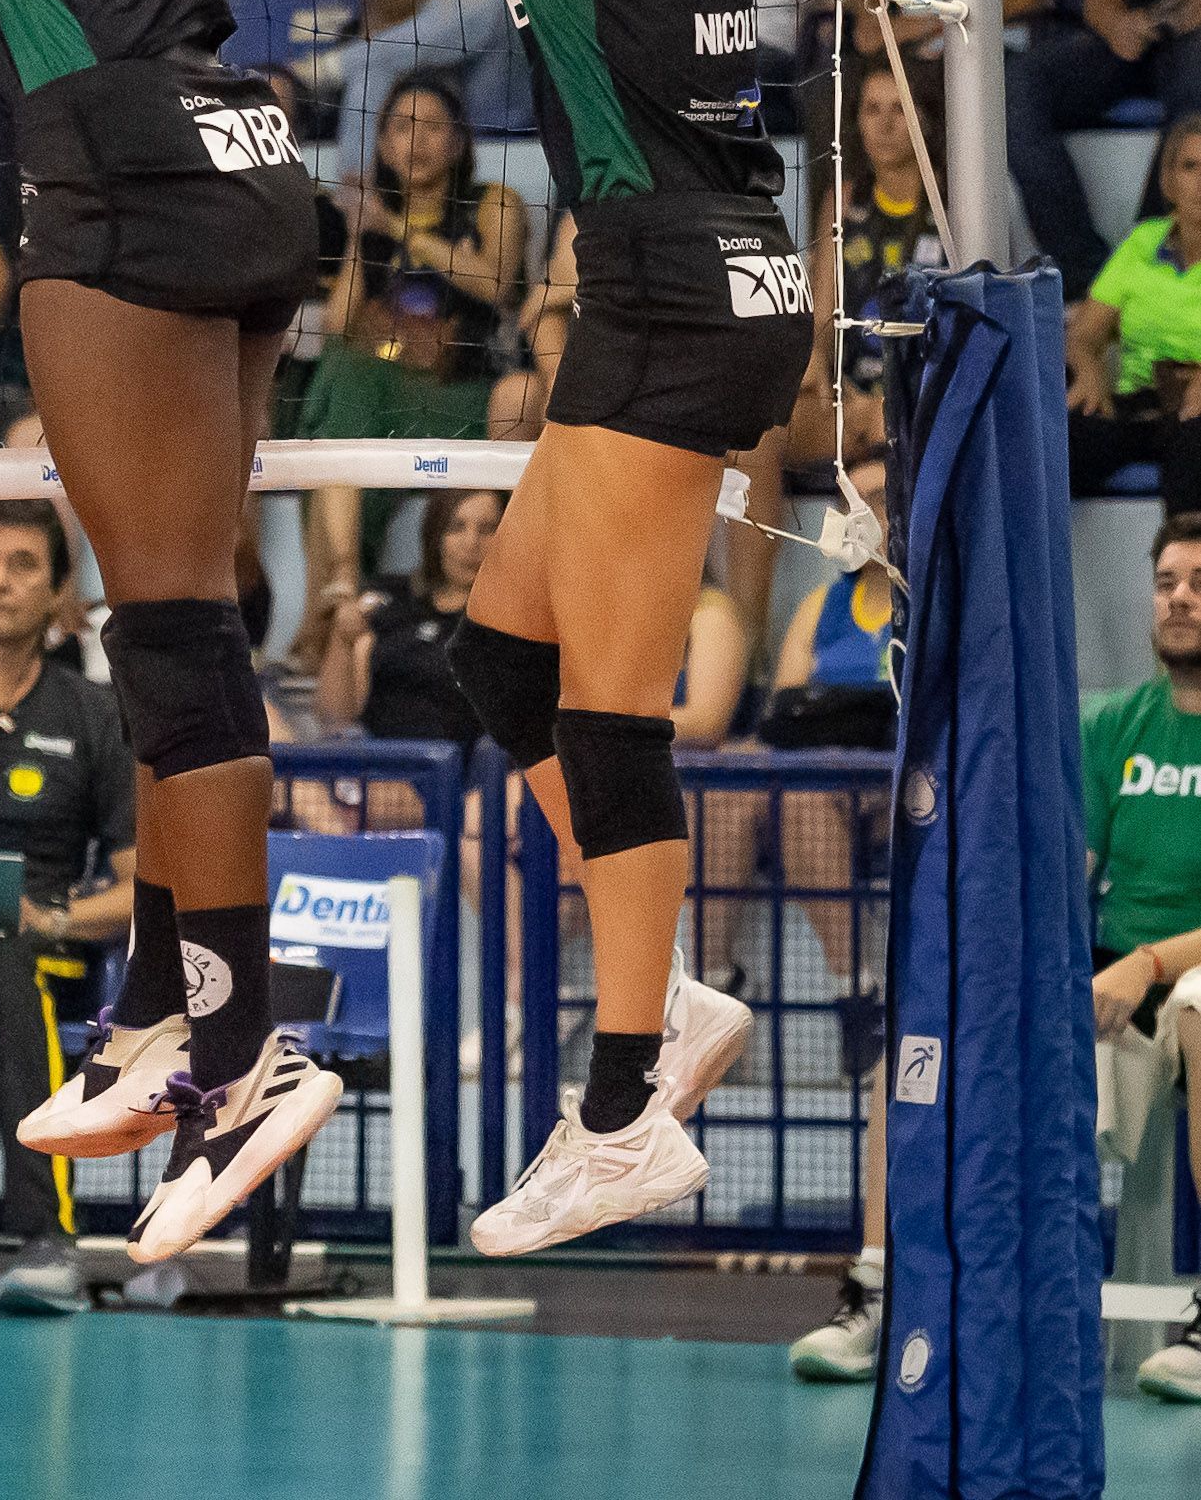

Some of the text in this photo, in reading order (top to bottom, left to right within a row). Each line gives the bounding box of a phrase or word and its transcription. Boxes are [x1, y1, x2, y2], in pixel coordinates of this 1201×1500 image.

[238, 104, 303, 167] BR
[717, 235, 762, 252] banco
[767, 252, 814, 315] BR
[413, 455, 448, 473] Dentil
[1119, 752, 1201, 797] Den
